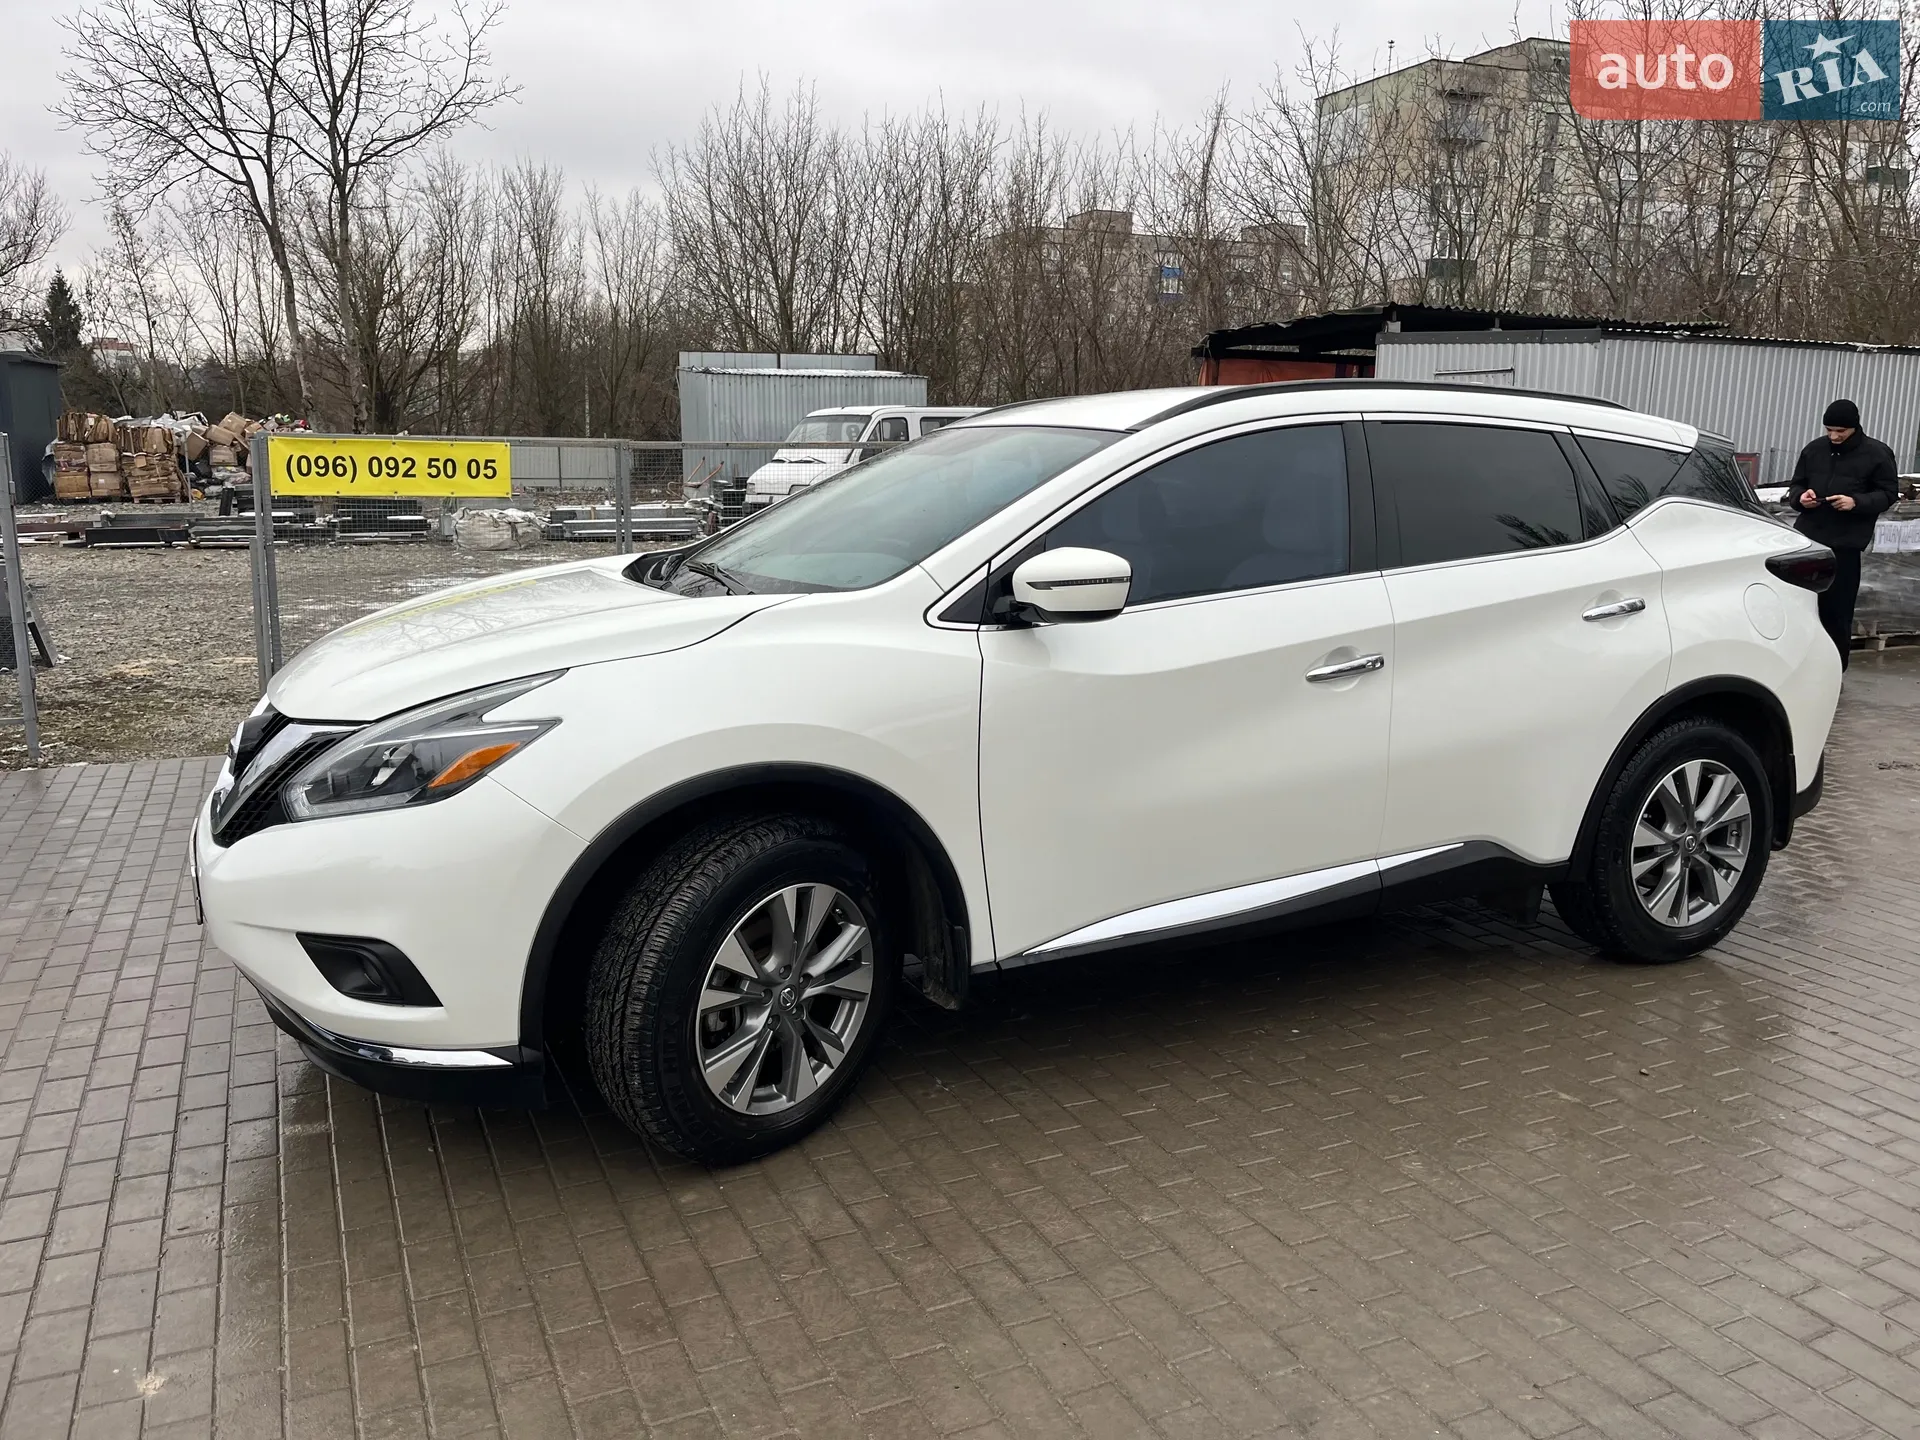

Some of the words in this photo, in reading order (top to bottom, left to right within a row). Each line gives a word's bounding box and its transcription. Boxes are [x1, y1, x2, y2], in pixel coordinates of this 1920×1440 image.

[286, 454, 358, 483] (096)
[368, 456, 417, 479] 092
[426, 457, 457, 480] 50
[467, 458, 498, 480] 05
